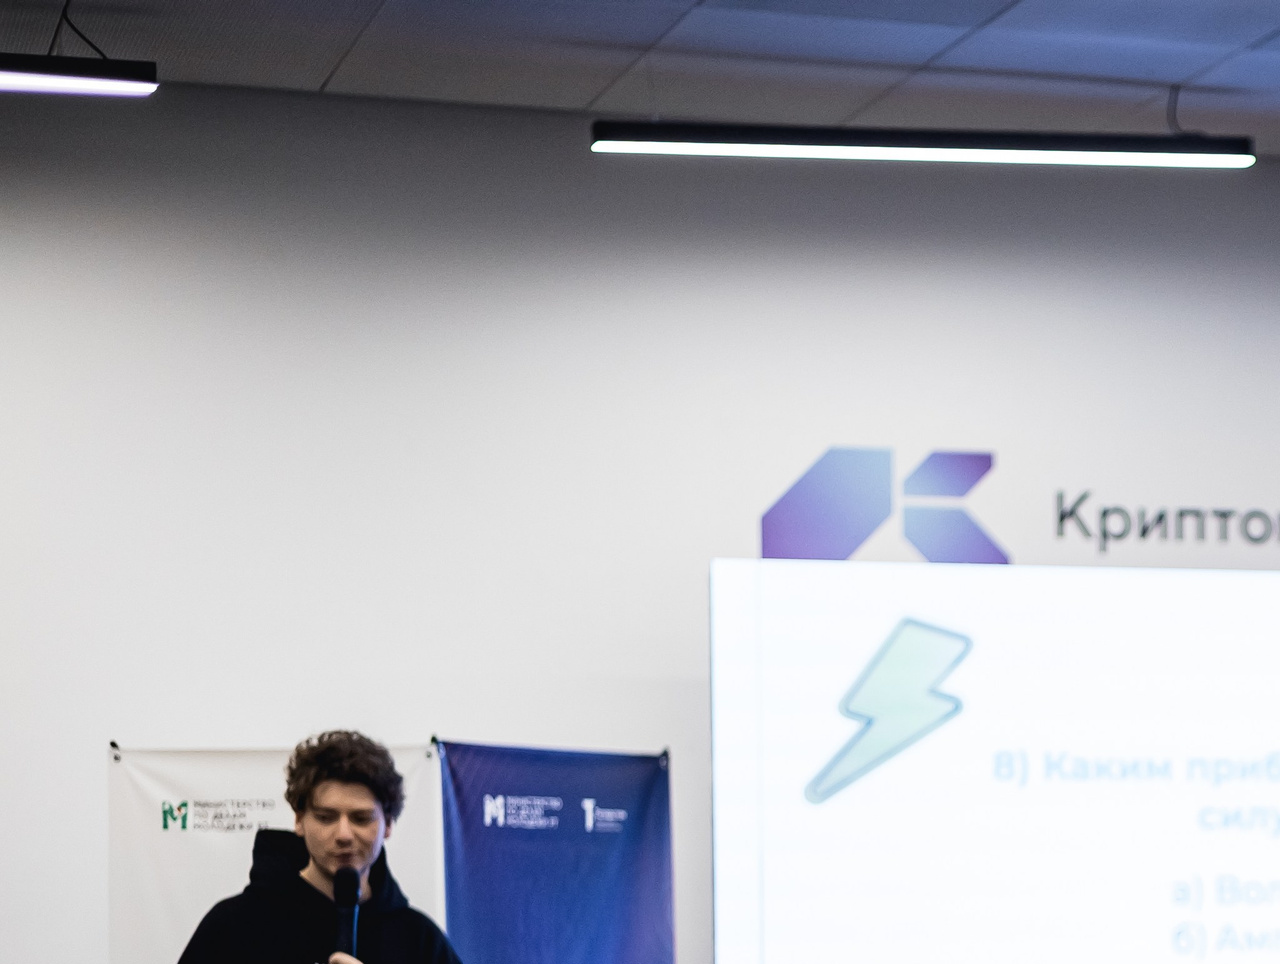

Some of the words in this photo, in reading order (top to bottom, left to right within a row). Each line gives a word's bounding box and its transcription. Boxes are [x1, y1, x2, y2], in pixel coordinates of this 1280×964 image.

[1043, 751, 1173, 782] Каким
[1171, 876, 1204, 911] а)
[1172, 923, 1207, 960] б)
